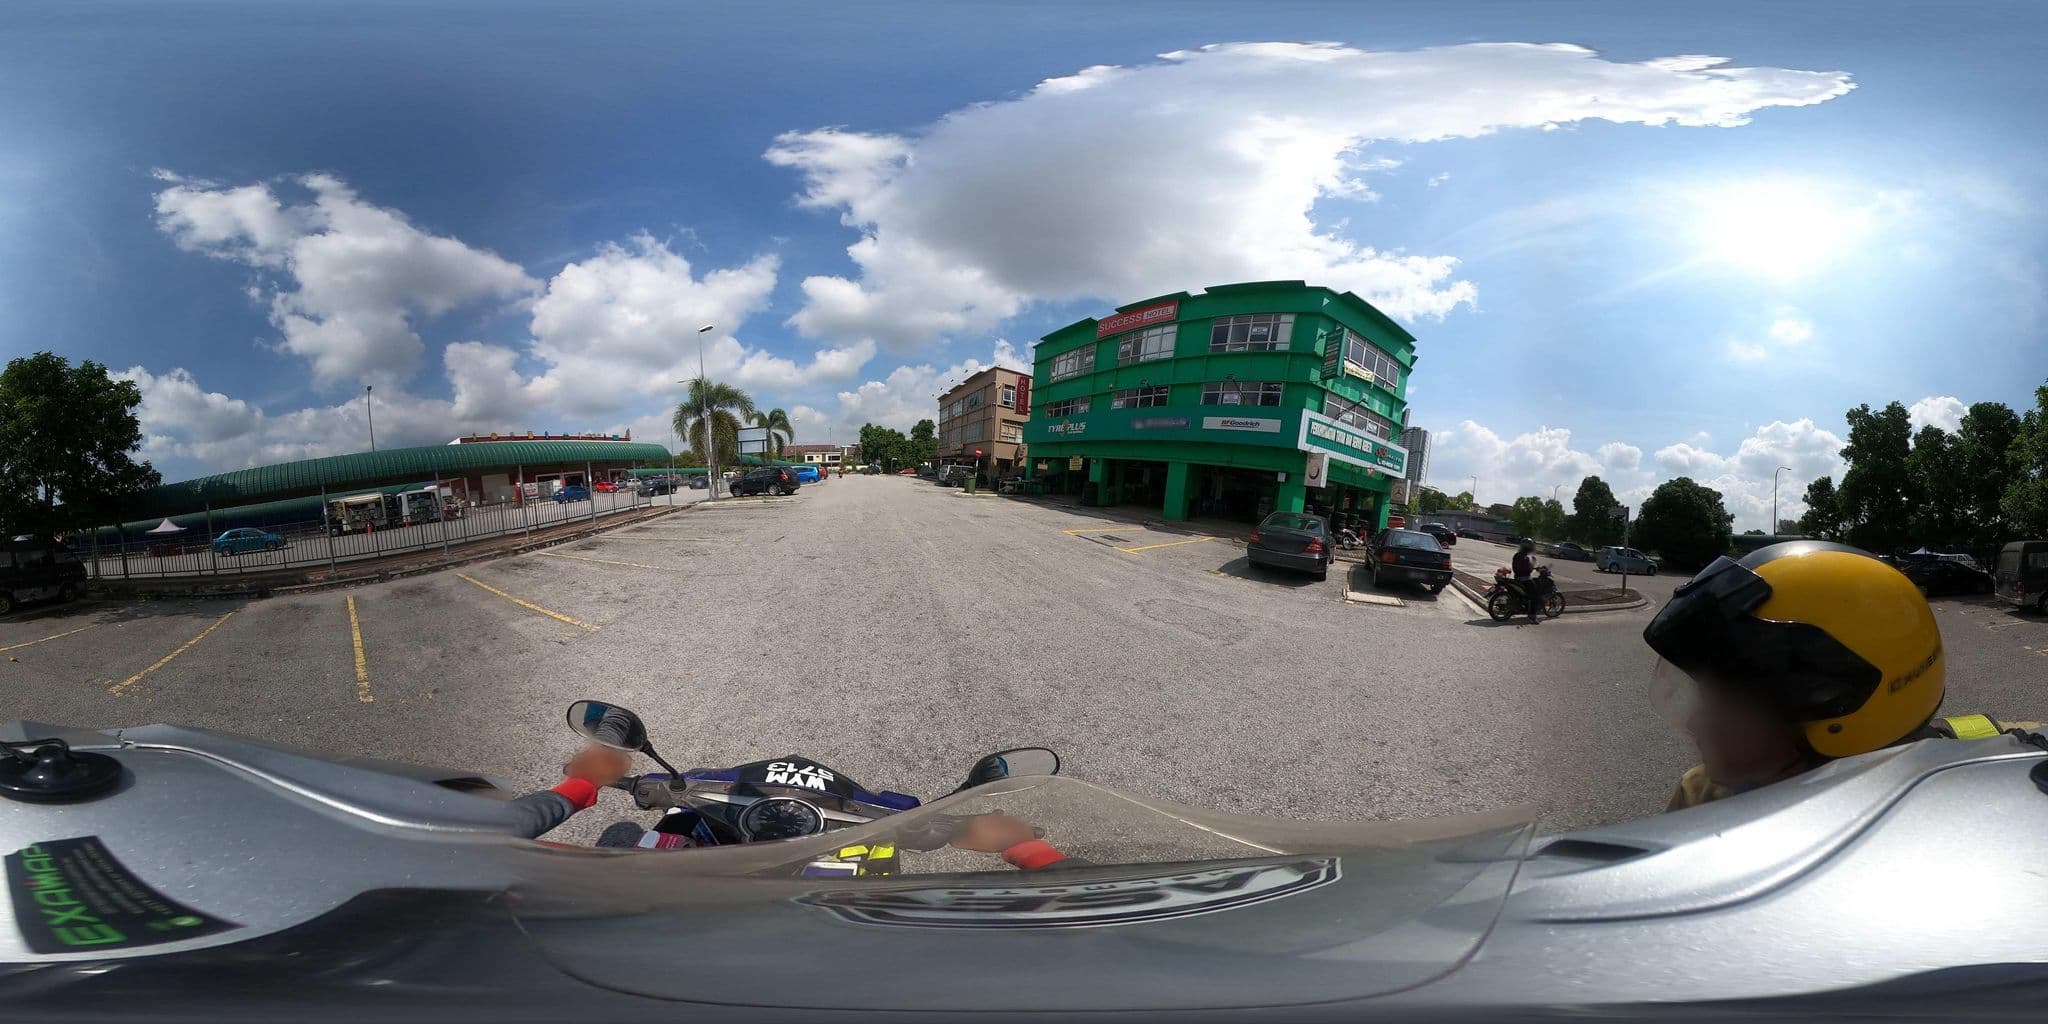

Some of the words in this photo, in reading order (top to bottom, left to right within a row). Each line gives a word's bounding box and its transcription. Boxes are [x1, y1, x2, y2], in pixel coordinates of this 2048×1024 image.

[1099, 313, 1142, 332] SUCCESS
[1146, 308, 1170, 318] HOTEL
[765, 771, 826, 791] WYM
[766, 762, 834, 782] 5713
